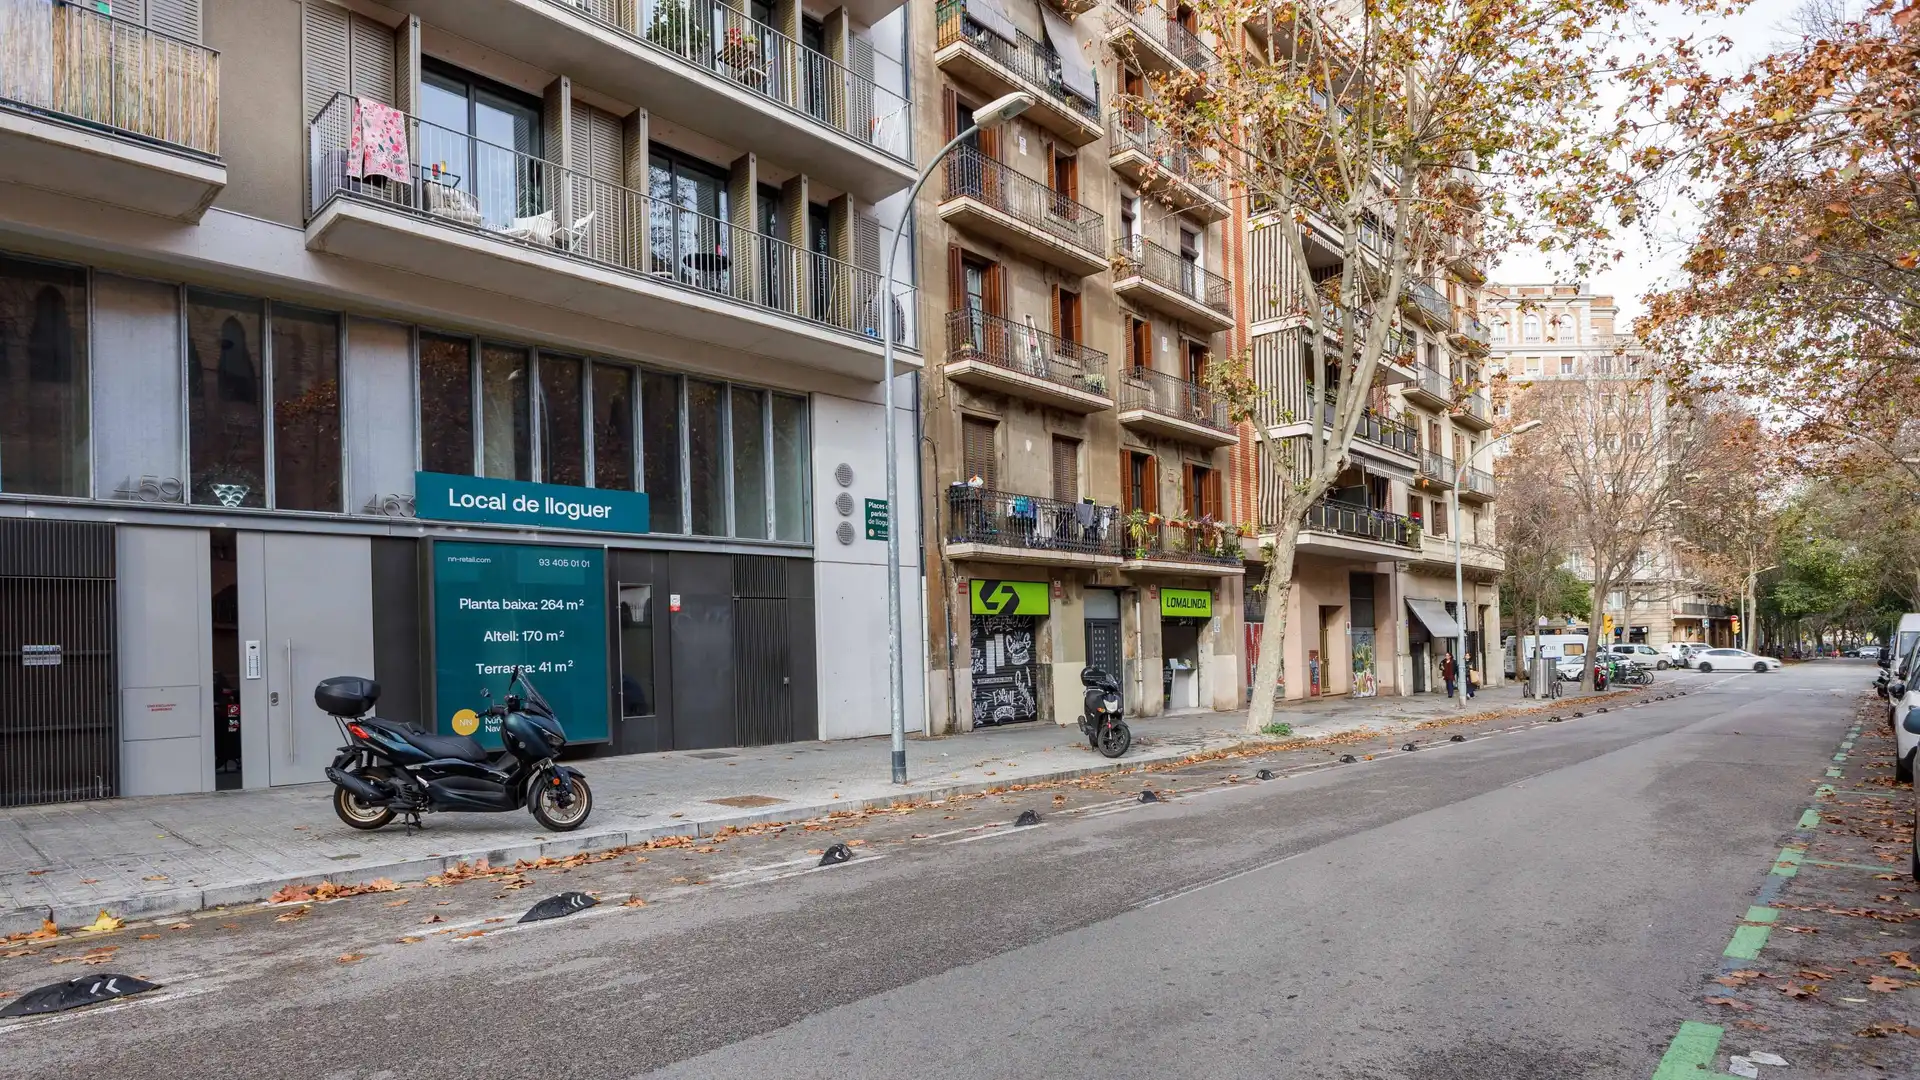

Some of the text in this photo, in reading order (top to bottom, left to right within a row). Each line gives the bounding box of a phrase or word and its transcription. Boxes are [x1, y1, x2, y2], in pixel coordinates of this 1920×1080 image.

[448, 488, 612, 521] Local de lloguer
[868, 501, 885, 509] Places
[875, 519, 889, 527] llogu
[447, 556, 491, 564] nn-retail.com
[538, 558, 590, 568] 93 405 01 01
[459, 598, 500, 610] Planta
[502, 599, 538, 610] baixa:
[540, 599, 564, 611] 264
[1166, 596, 1207, 609] LOMALINDA
[483, 630, 519, 642] Altell:
[522, 631, 543, 642] 170
[538, 661, 552, 673] 41
